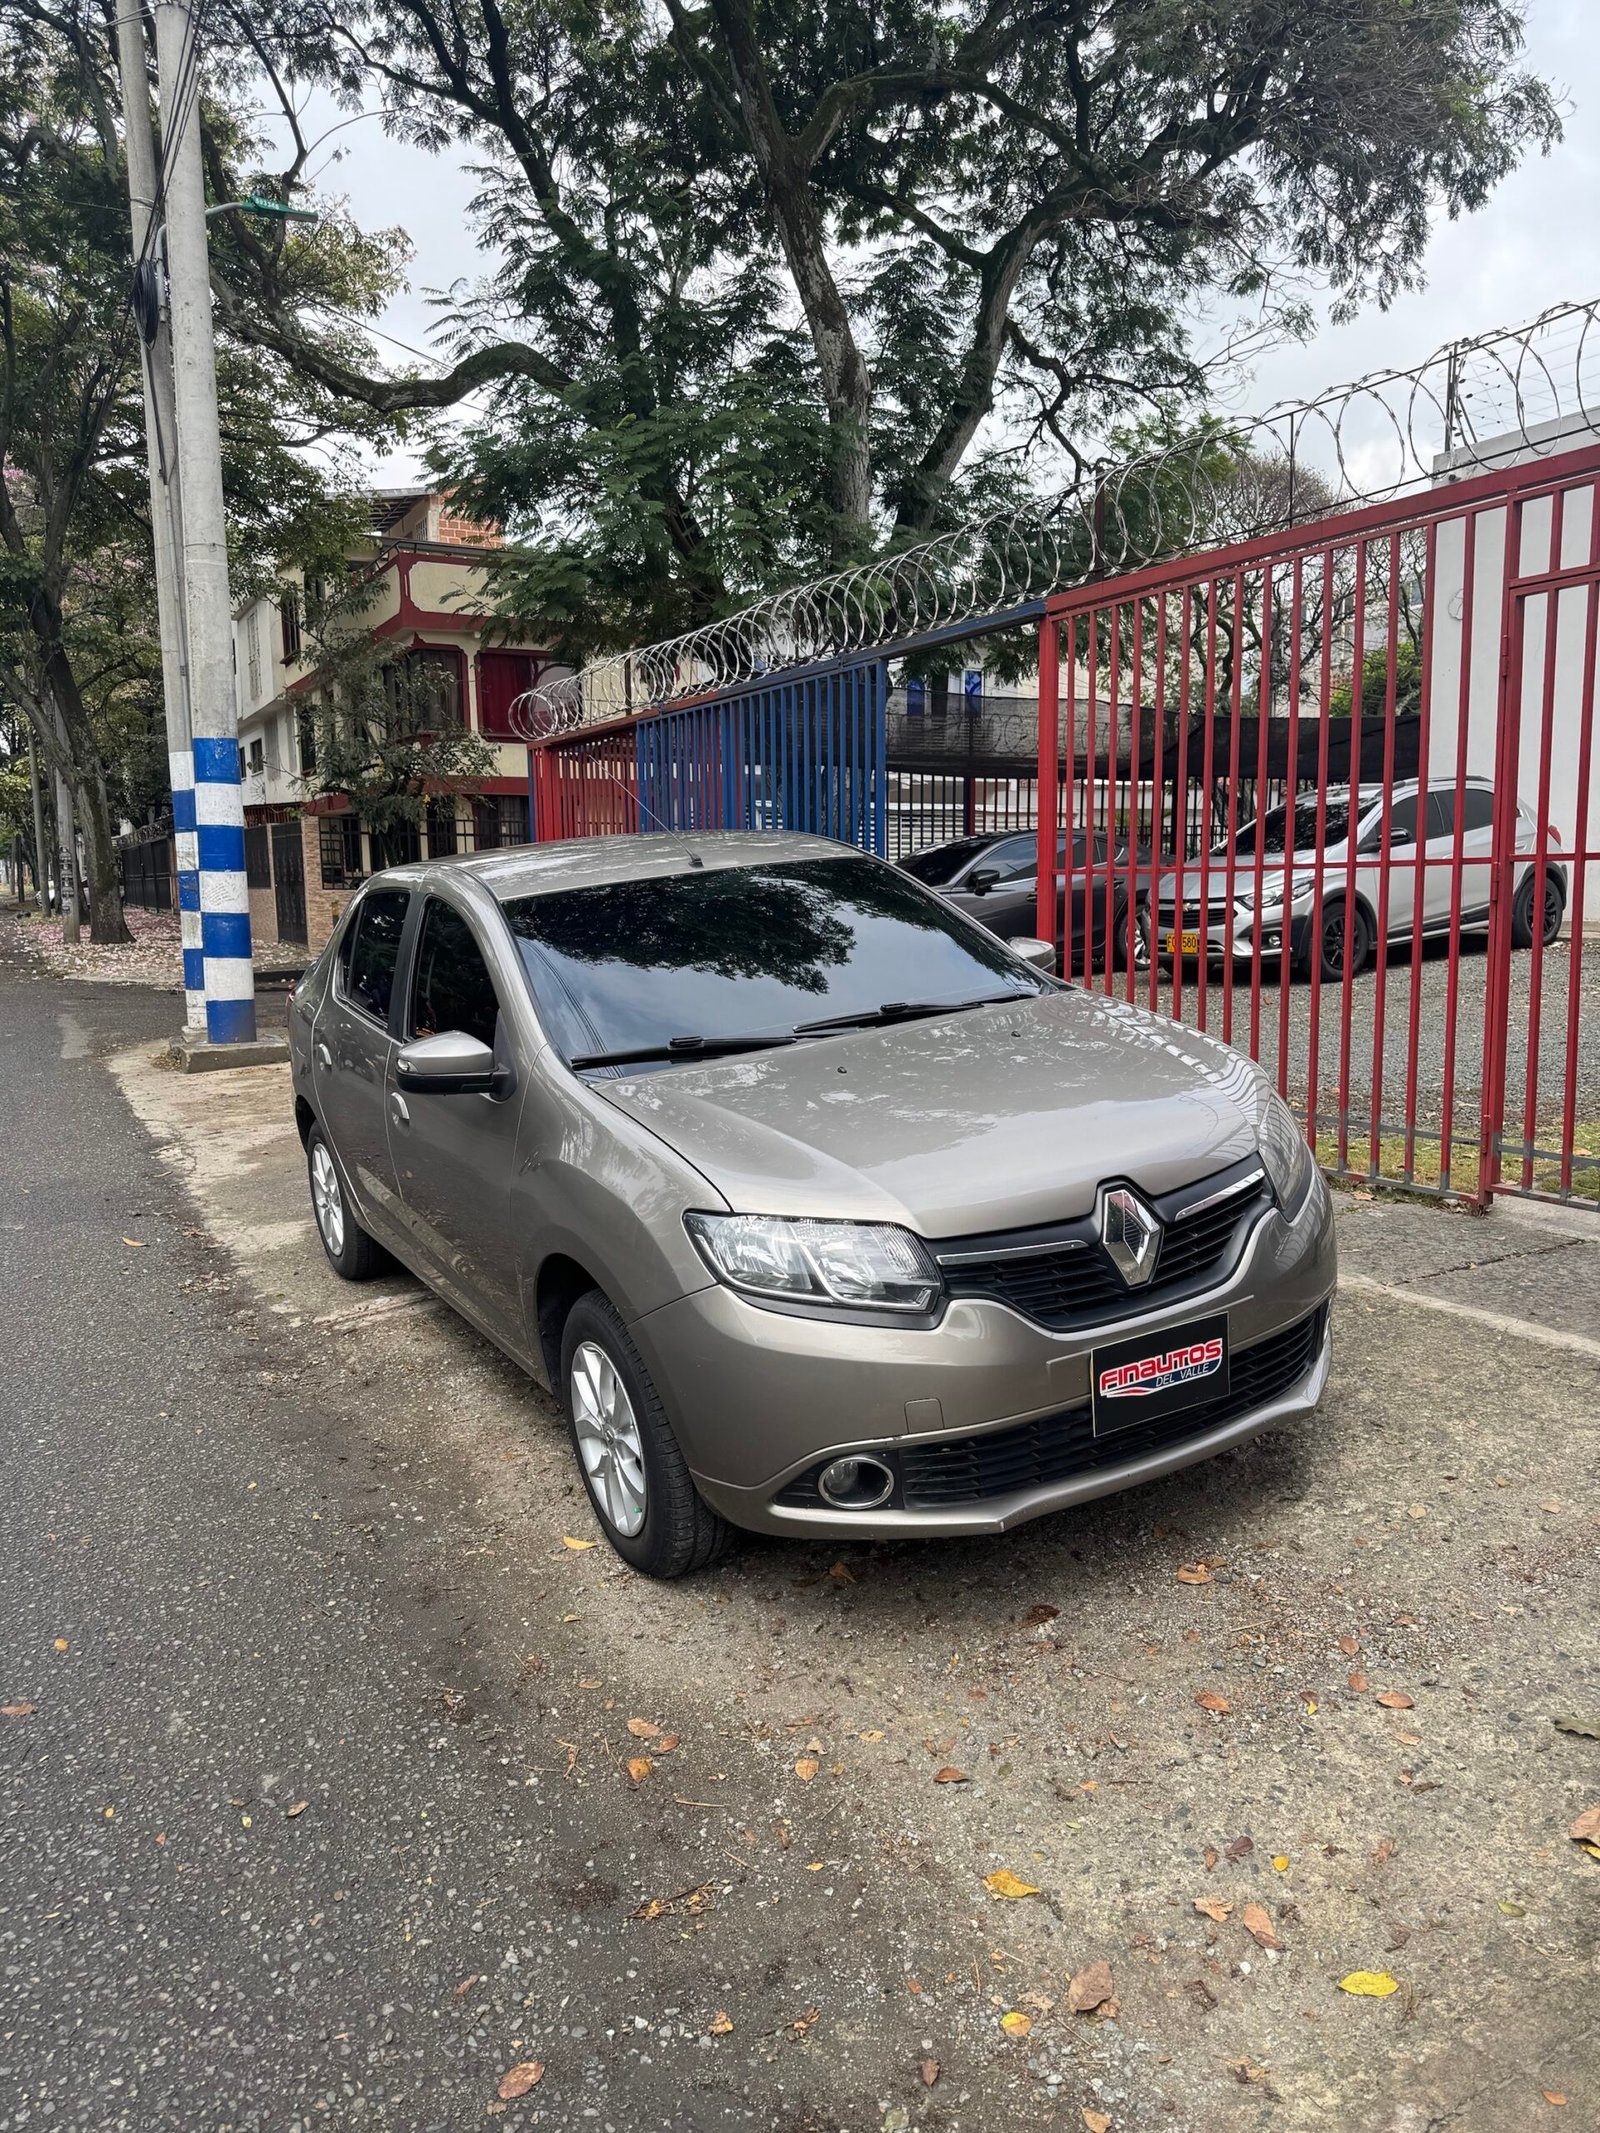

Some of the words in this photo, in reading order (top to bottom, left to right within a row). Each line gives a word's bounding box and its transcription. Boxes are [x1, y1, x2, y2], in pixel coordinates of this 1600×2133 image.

[1167, 936, 1196, 948] F580
[1155, 1373, 1175, 1387] DEL
[1180, 1362, 1210, 1378] VALLE
